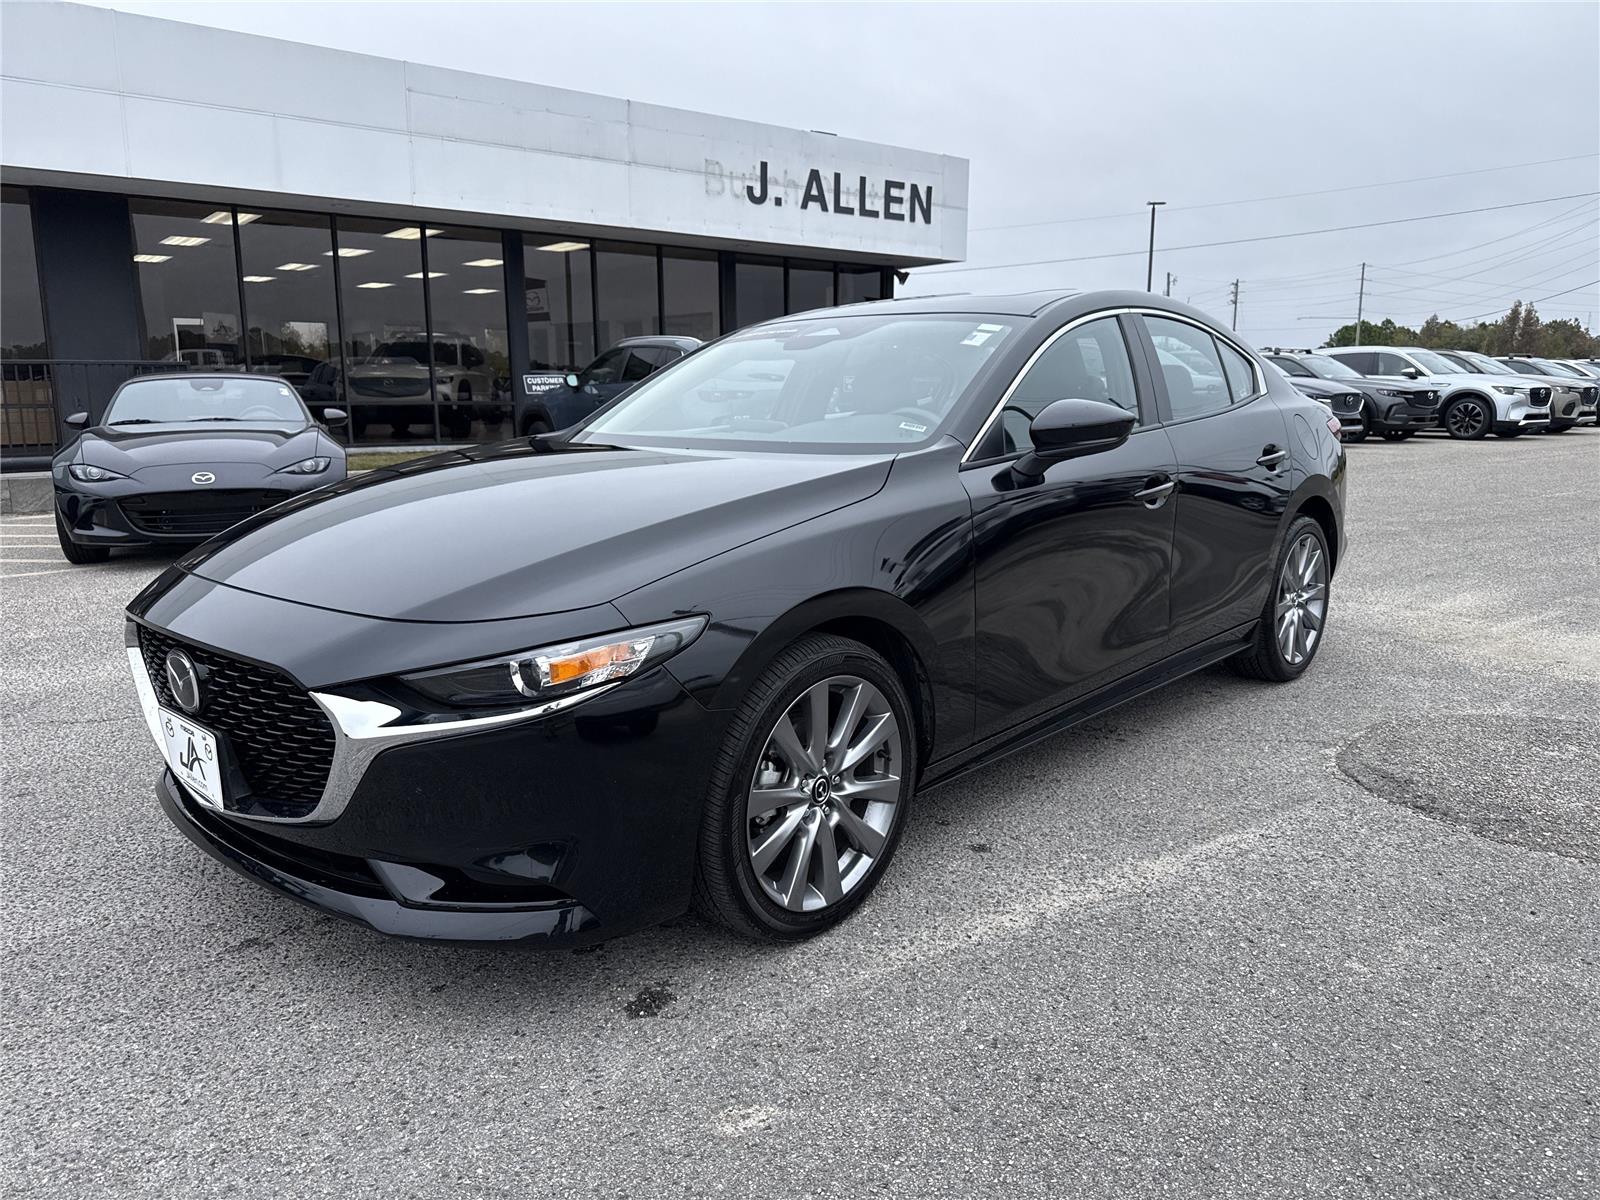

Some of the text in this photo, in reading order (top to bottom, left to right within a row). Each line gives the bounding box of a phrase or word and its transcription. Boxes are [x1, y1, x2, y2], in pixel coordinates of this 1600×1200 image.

[746, 161, 782, 207] J.
[800, 168, 933, 225] ALLEN
[180, 737, 207, 781] JA
